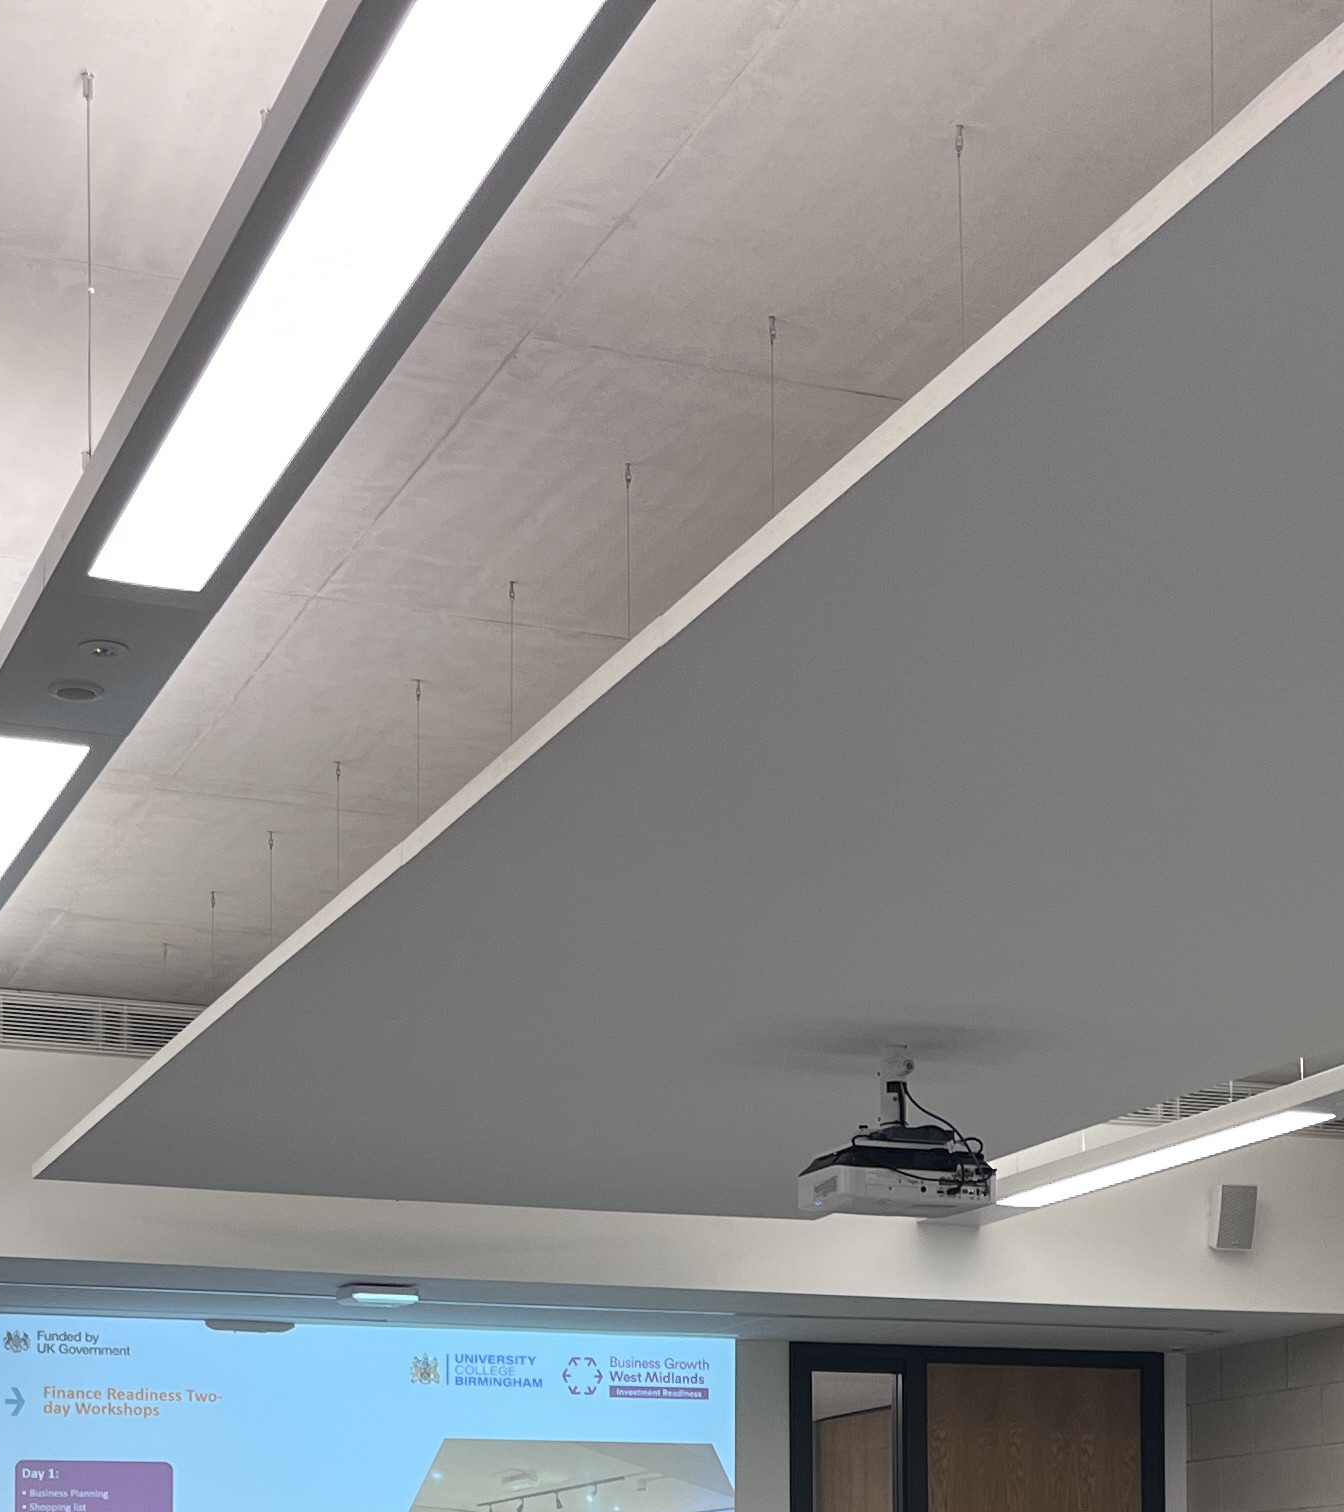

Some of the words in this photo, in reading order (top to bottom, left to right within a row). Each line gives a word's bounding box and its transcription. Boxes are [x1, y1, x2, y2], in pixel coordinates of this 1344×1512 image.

[37, 1330, 81, 1342] Funded
[85, 1332, 99, 1344] by
[37, 1344, 56, 1354] UK
[58, 1345, 131, 1356] Government
[455, 1354, 537, 1366] UNIVERSITY
[609, 1356, 660, 1369] Business
[664, 1357, 710, 1371] Growth
[455, 1365, 516, 1376] COLLEGE
[455, 1377, 543, 1388] BIRMINGHAM
[609, 1371, 642, 1383] West
[644, 1371, 705, 1385] Midlands
[43, 1386, 102, 1400] Finance
[107, 1387, 182, 1402] Readiness
[187, 1389, 223, 1402] Two-
[616, 1388, 661, 1397] Investment
[662, 1389, 703, 1398] Readiness
[43, 1402, 71, 1417] day
[75, 1402, 160, 1419] Workshops
[22, 1468, 45, 1480] Day
[48, 1468, 59, 1479] 1:
[29, 1489, 68, 1498] Business
[70, 1489, 109, 1500] Planning
[29, 1502, 71, 1512] Shopping
[73, 1503, 87, 1512] list
